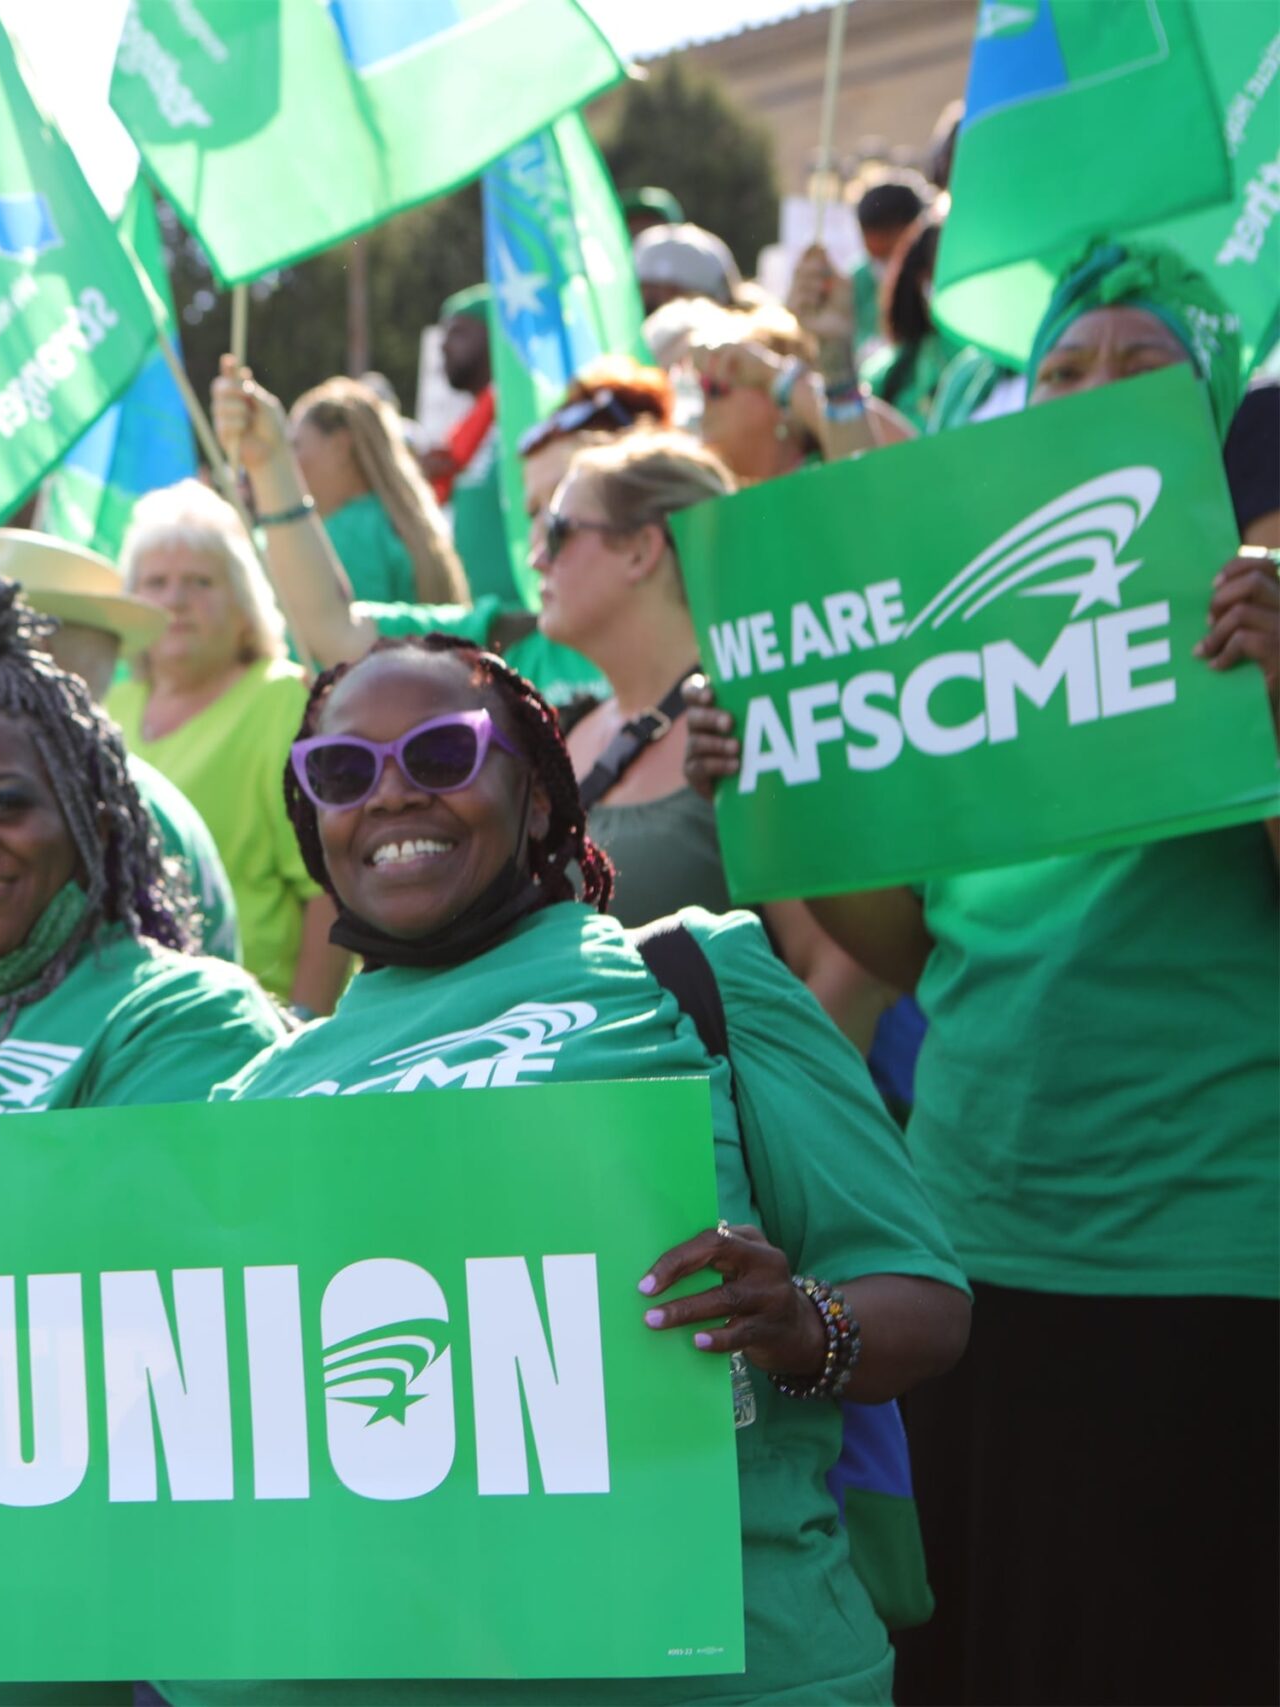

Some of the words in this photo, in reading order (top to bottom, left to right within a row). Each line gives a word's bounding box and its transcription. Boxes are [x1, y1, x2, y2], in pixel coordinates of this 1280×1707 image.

[709, 611, 785, 682] WE
[791, 578, 907, 665] ARE
[738, 600, 1177, 794] AFSCME
